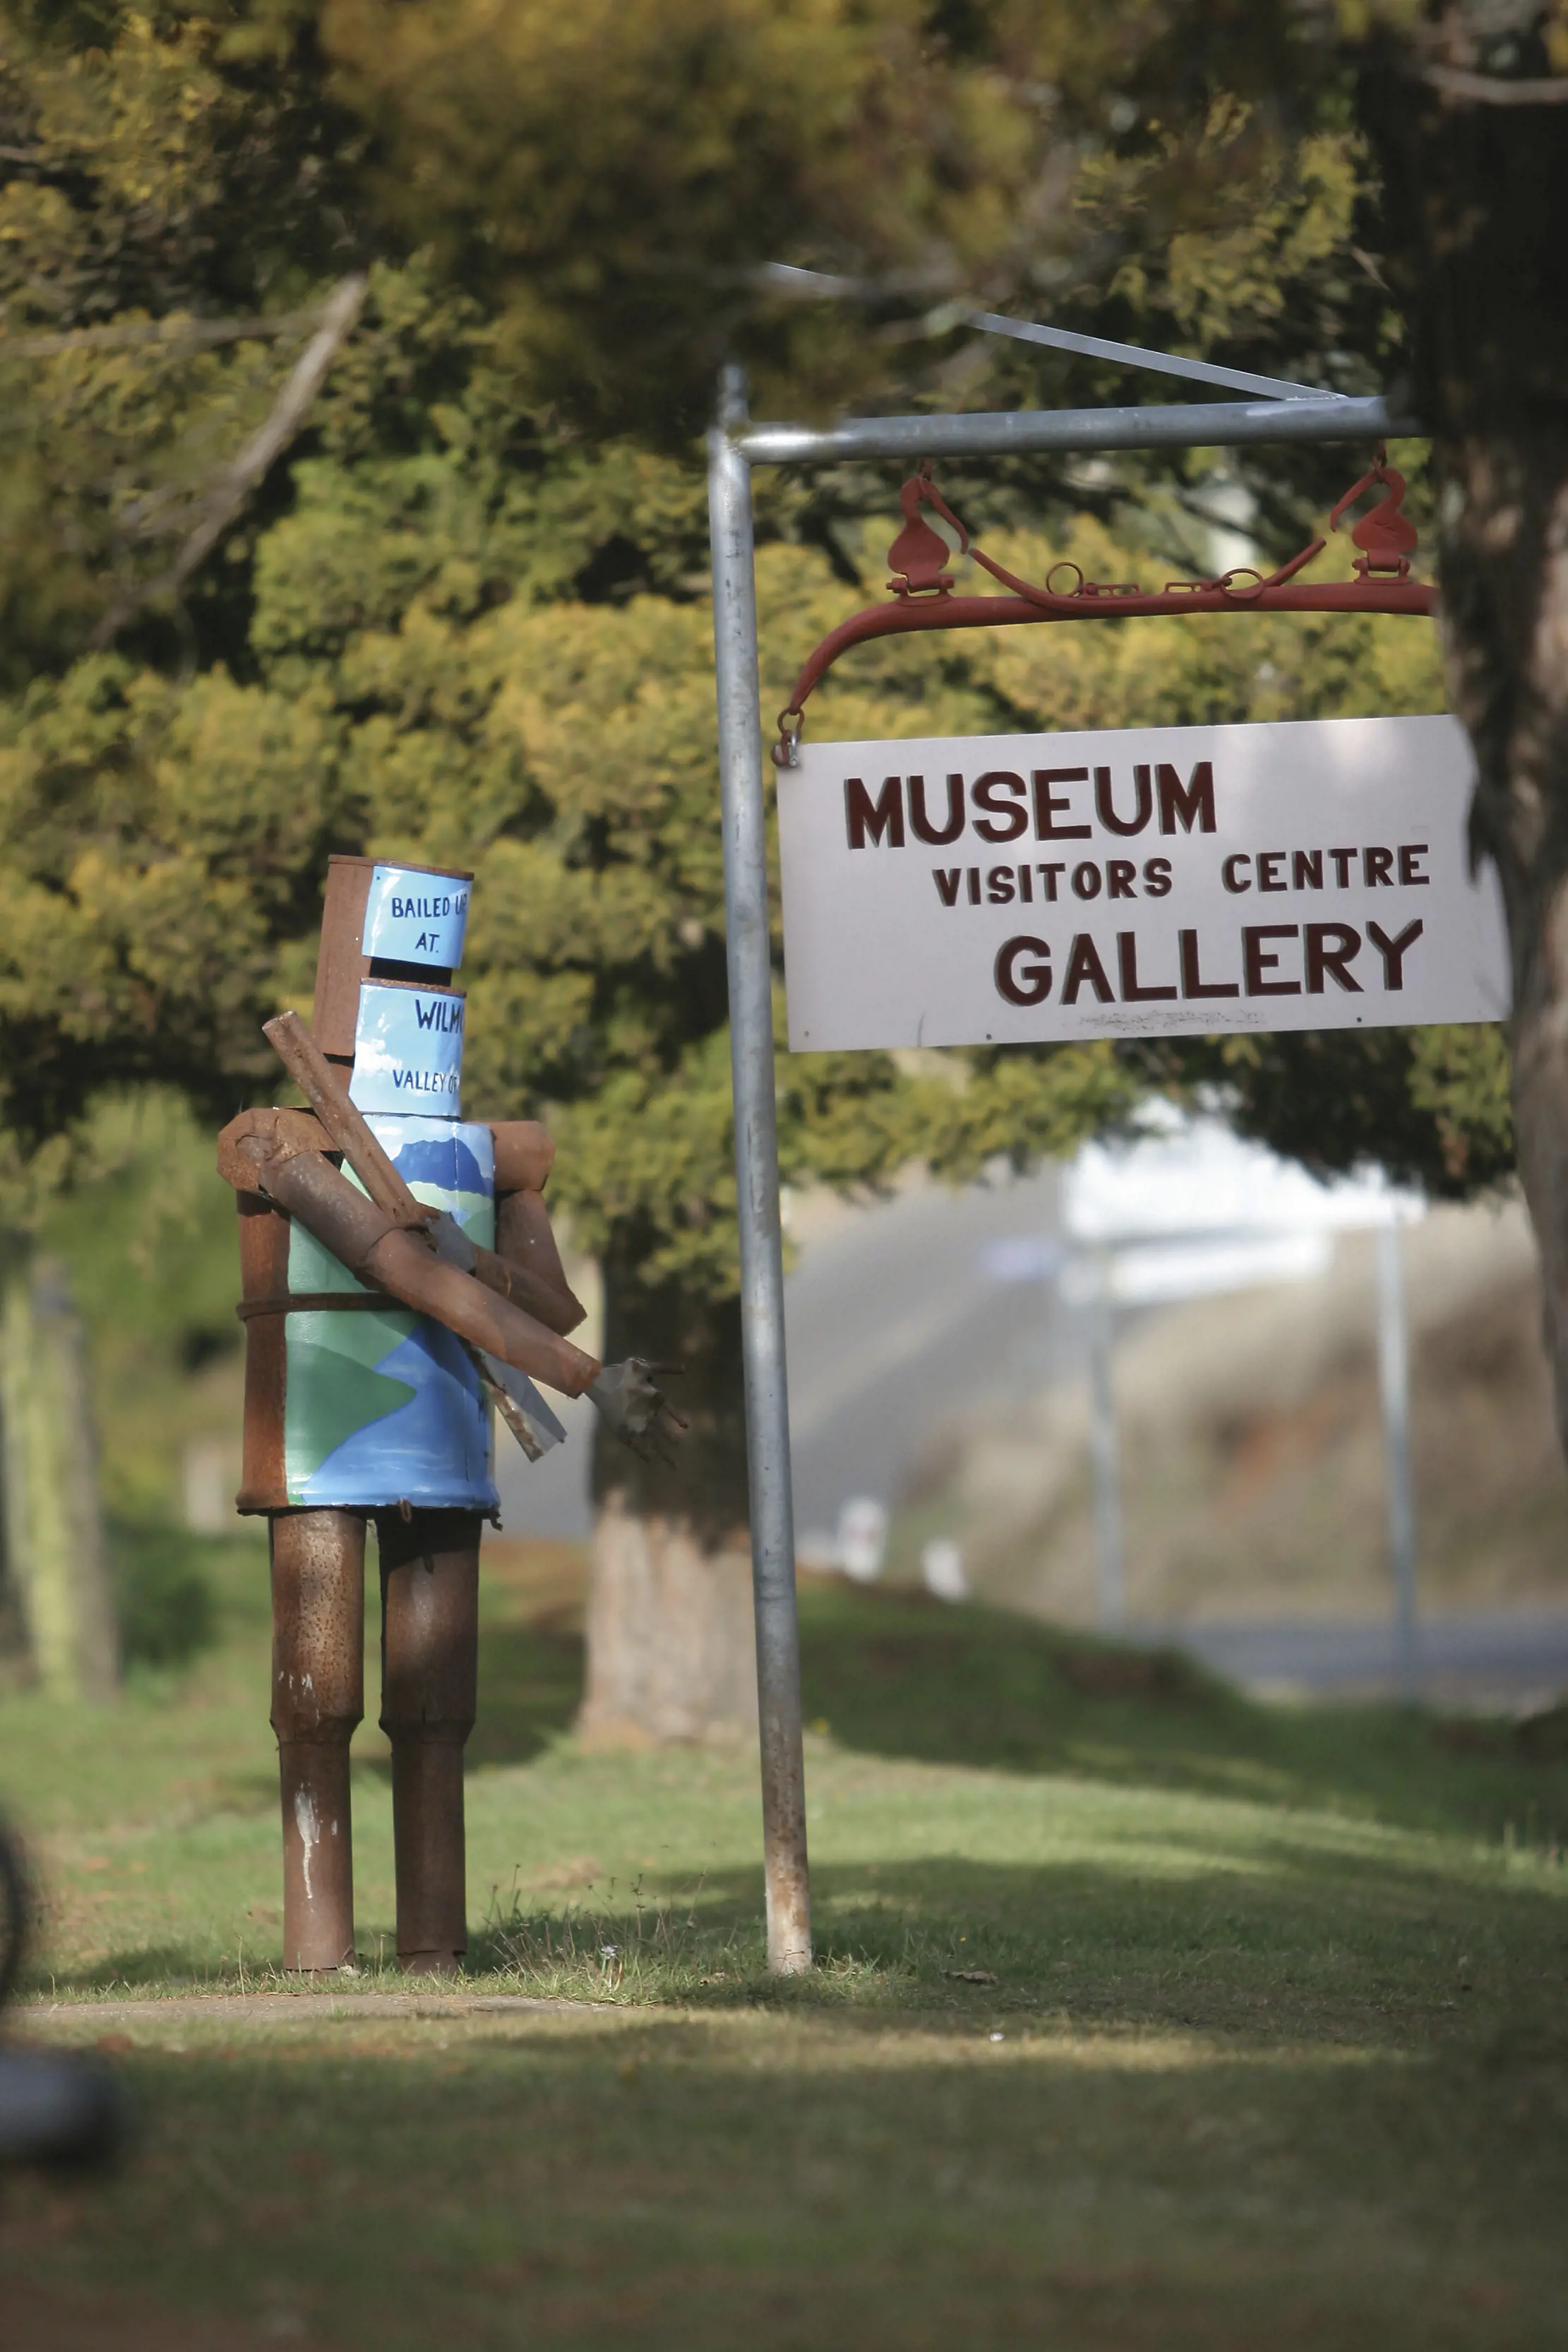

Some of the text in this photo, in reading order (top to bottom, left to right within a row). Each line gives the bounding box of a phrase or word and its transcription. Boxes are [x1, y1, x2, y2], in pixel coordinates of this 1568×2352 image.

[844, 761, 1217, 850] MUSEUM
[932, 843, 1430, 907] VISITORS CENTRE
[392, 897, 450, 918] BAILED
[415, 932, 440, 953] AT.
[994, 919, 1424, 1008] GALLERY
[393, 1070, 446, 1094] VALLEY
